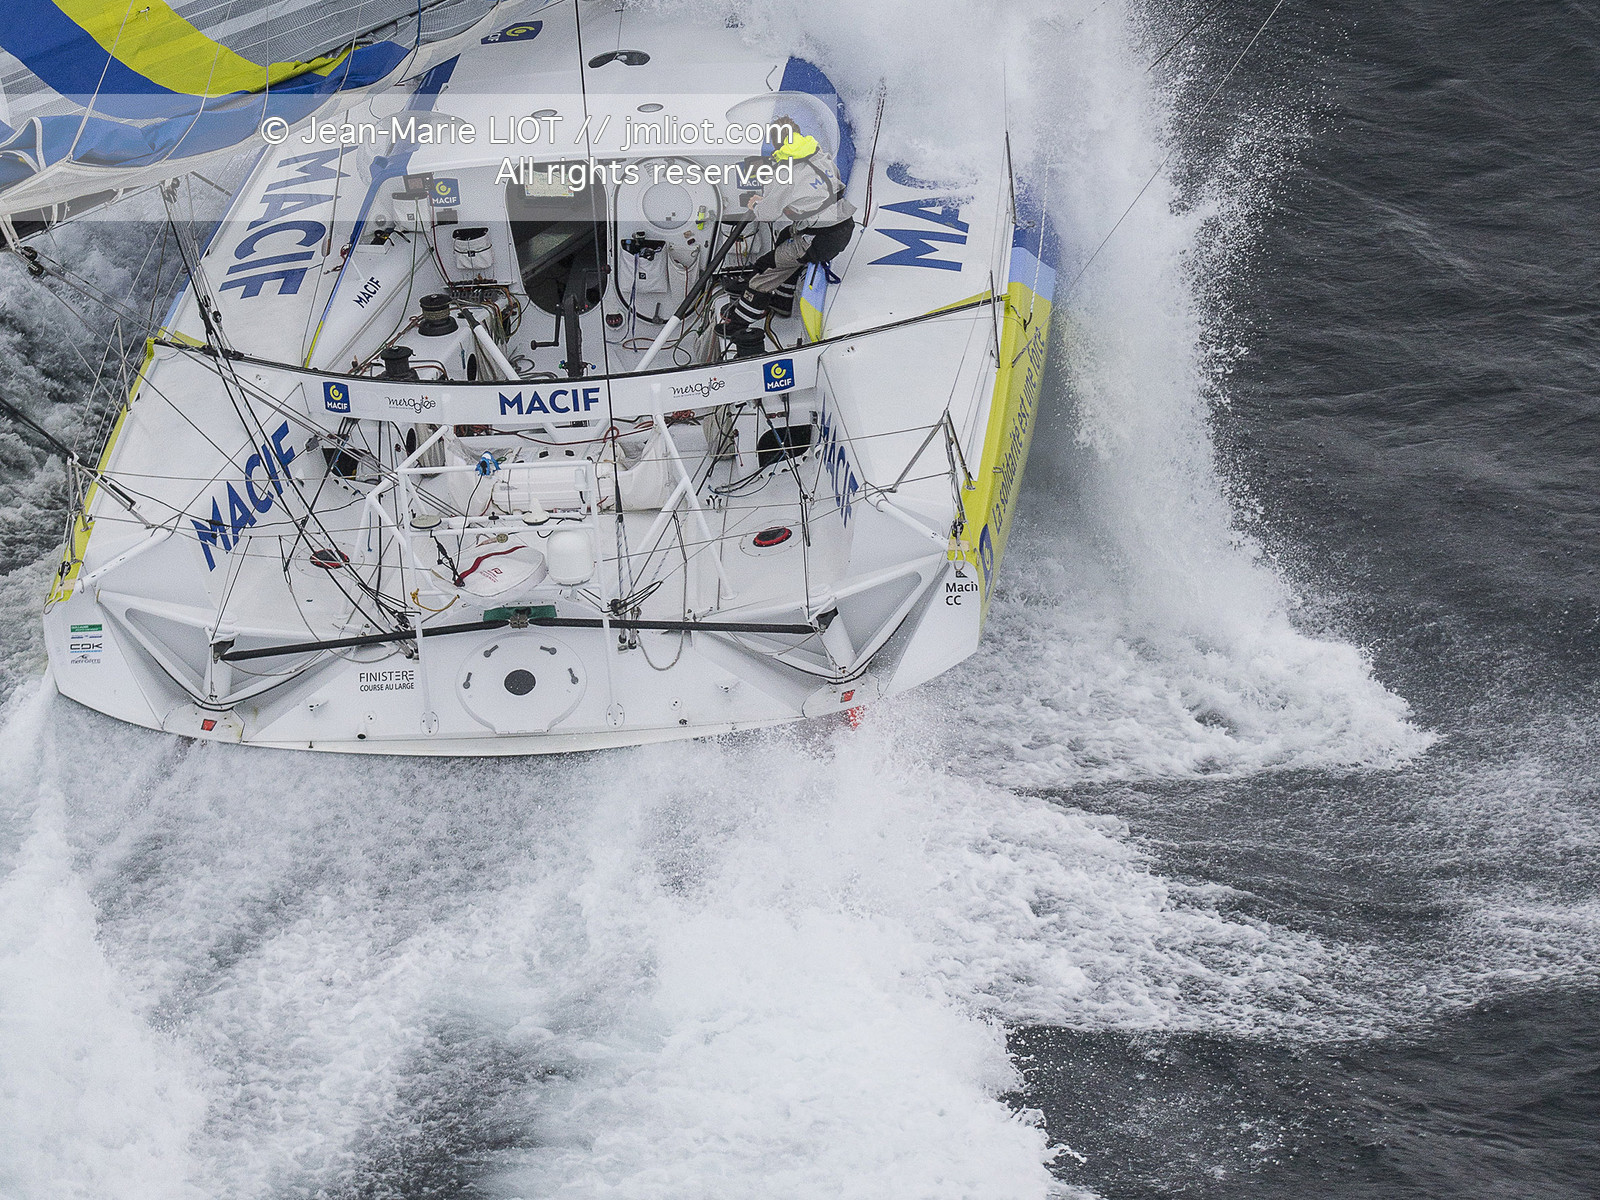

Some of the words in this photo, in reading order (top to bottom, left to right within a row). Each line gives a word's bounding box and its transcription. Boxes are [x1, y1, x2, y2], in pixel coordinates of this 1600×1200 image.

[432, 196, 457, 205] MACIF
[219, 145, 359, 301] MACIF
[353, 276, 382, 309] MACIF
[767, 378, 792, 390] MACIF
[327, 401, 348, 410] MACIF
[498, 387, 601, 416] MACIF
[991, 503, 1003, 536] La
[1023, 366, 1037, 409] une
[190, 420, 297, 572] MACIF
[946, 595, 962, 606] CC
[359, 684, 384, 692] COURSE
[384, 683, 394, 691] AU
[394, 682, 415, 690] LARGE
